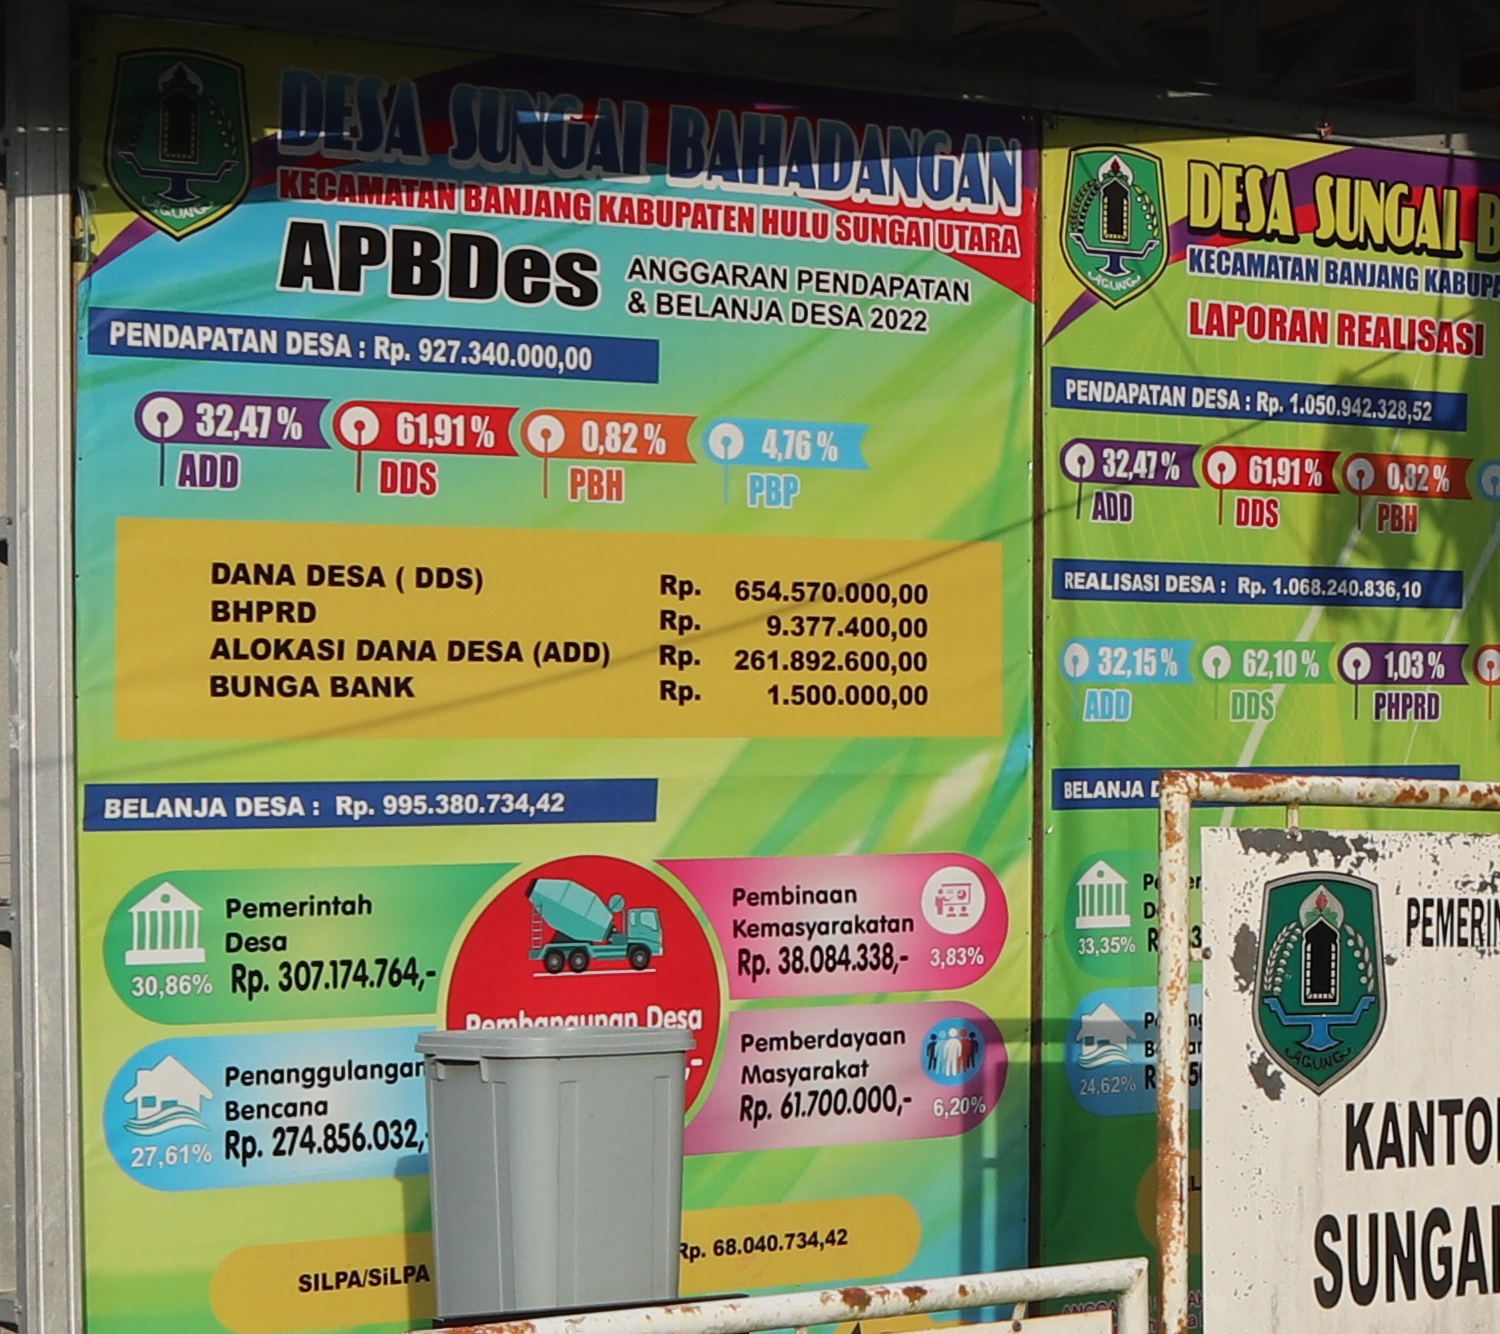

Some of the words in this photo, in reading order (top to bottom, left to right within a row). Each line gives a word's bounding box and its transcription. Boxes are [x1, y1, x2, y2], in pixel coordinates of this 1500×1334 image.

[278, 69, 429, 163] DESA
[450, 82, 647, 177] SUNGAI
[667, 105, 1021, 215] BAHADANGAN
[278, 168, 457, 212] KECAMATAN
[463, 183, 591, 222] BANJANG
[598, 192, 755, 235] KABUPATEN
[760, 207, 829, 241] HULU
[834, 212, 933, 251] SUNGAI
[937, 219, 1020, 257] UTARA
[1188, 161, 1299, 242] DESA
[1316, 173, 1460, 256] SUNGAI
[278, 222, 600, 309] APBDes
[628, 256, 788, 294] ANGGARAN
[797, 268, 970, 304] PENDAPATAN
[1187, 247, 1321, 283] KECAMATAN
[1325, 259, 1419, 292] BANJANG
[652, 292, 785, 324] BELANJA
[792, 298, 864, 329] DESA
[870, 304, 928, 333] 2022
[1188, 301, 1332, 346] LAPORAN
[1337, 312, 1485, 357] REALISASI
[109, 320, 277, 355] PENDAPATAN
[286, 331, 351, 359] DESA
[418, 339, 592, 374] 927.340.000,00
[1066, 378, 1186, 409] PENDAPATAN
[1192, 386, 1240, 410] DESA
[1290, 392, 1432, 424] 1.050.942.328,52
[177, 451, 240, 490] ADD
[378, 459, 438, 497] DDS
[568, 465, 626, 504] PBH
[746, 472, 801, 510] PBP
[1091, 491, 1133, 523] ADD
[1235, 497, 1280, 530] DDS
[1375, 502, 1420, 535] PBH
[211, 562, 296, 588] DANA
[306, 564, 386, 591] DESA
[1064, 571, 1160, 594] REALISASI
[1164, 574, 1216, 595] DESA
[1272, 577, 1422, 603] 1.068.240.836,10
[734, 580, 928, 611] 654.570.000,00
[211, 600, 317, 624] BHPRD
[766, 614, 928, 644] 9.377.400,00
[210, 637, 345, 664] ALOKASI
[354, 639, 438, 664] DANA
[447, 641, 524, 665] DESA
[532, 639, 611, 670] (ADD)
[734, 649, 928, 677] 261.892.600,00
[209, 674, 321, 700] BUNGA
[329, 676, 414, 700] BANK
[766, 685, 928, 712] 1.500.000,00
[1083, 689, 1132, 722] ADD
[1229, 689, 1275, 722] DDS
[1373, 691, 1442, 723] PHPRD
[1064, 778, 1144, 800] BELANJA
[104, 797, 226, 820] BELANJA
[235, 795, 308, 819] DESA
[382, 792, 565, 820] 995.380.734,42
[226, 895, 373, 921] Pemerintah
[732, 884, 858, 909] Pembinaan
[732, 911, 915, 939] Kemasyarakatan
[226, 931, 288, 955] Desa
[778, 941, 908, 977] 38.084.338,-
[929, 947, 984, 968] 3,83%
[1078, 937, 1136, 955] 33,35%
[130, 974, 212, 1000] 30,86%
[279, 957, 436, 992] 307.174.764,-
[647, 1005, 702, 1030] Desa
[741, 1027, 906, 1055] Pemberdayaan
[741, 1059, 870, 1085] Masyarakat
[1079, 1077, 1136, 1095] 24,62%
[225, 1097, 329, 1121] Bencana
[780, 1084, 911, 1117] 61.700.000,-
[933, 1096, 986, 1118] 6,20%
[130, 1142, 212, 1169] 27,61%
[713, 1226, 848, 1257] 68.040.734,42
